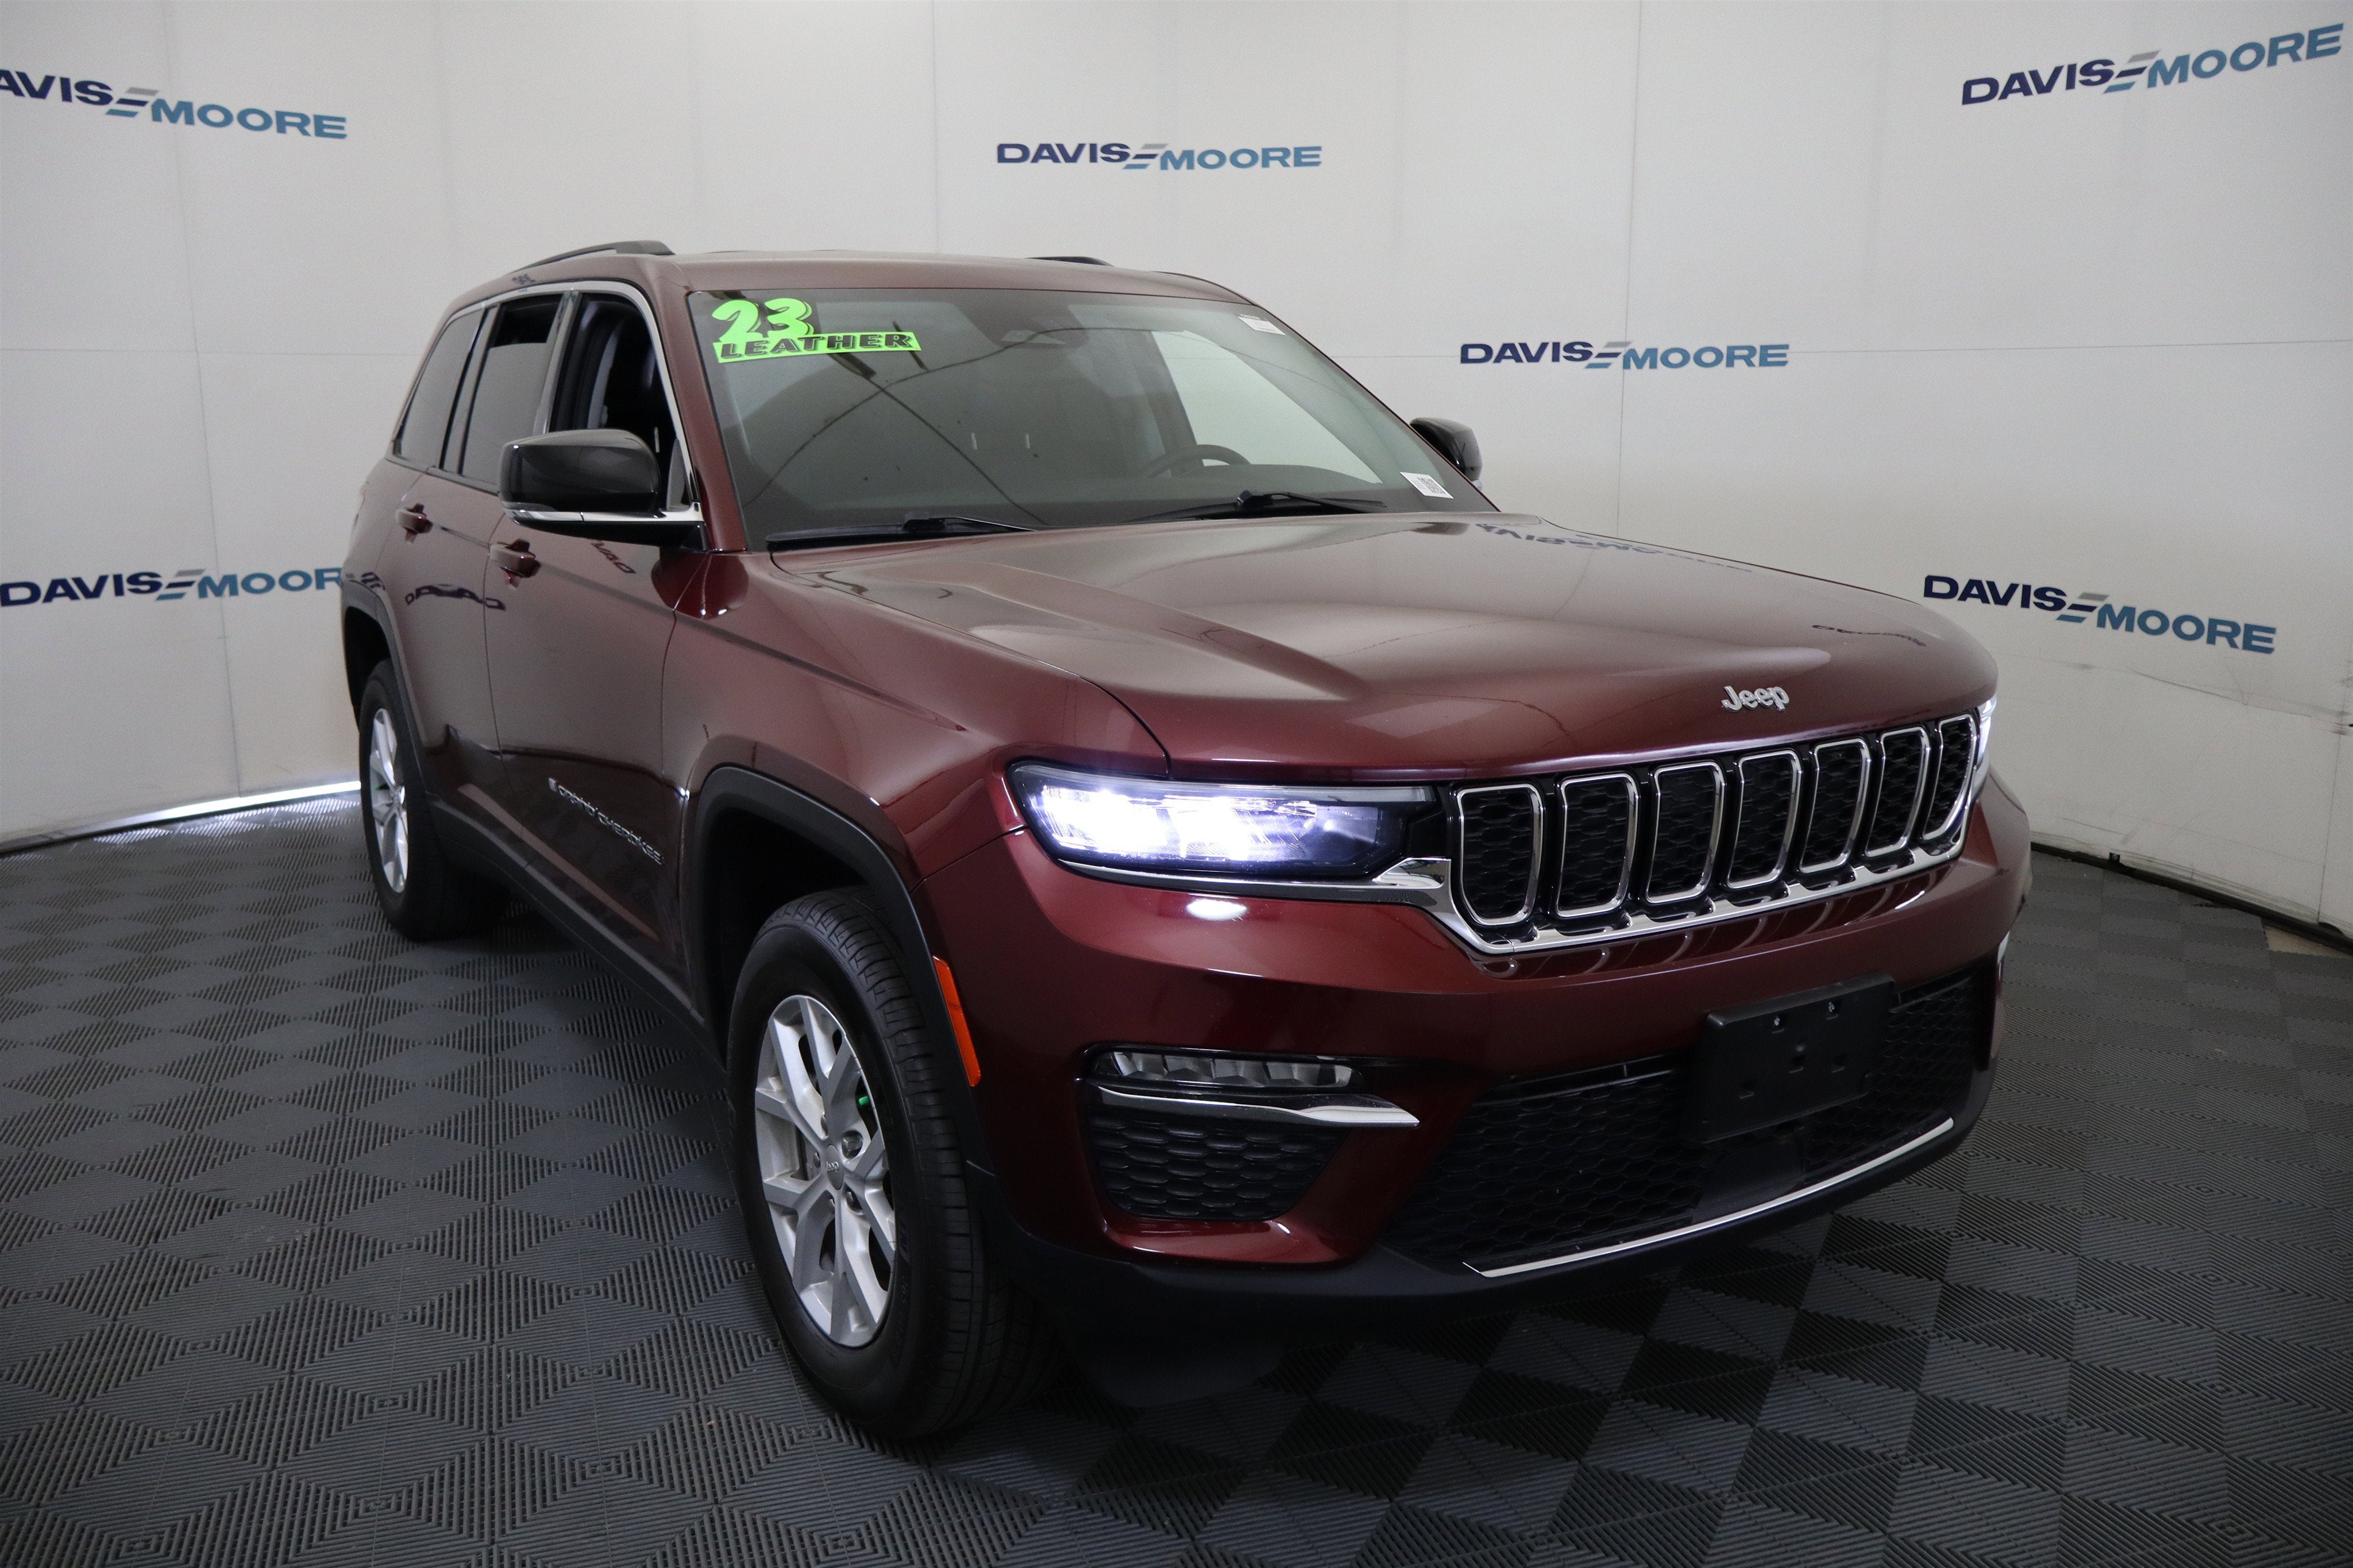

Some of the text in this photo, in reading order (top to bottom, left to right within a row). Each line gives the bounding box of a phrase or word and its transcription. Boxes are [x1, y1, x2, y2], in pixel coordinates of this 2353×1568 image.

[1962, 24, 2345, 105] DAVIS MOORE
[0, 69, 348, 140] AVIS MOORE
[997, 143, 1322, 171] DAVIS MOORE
[712, 298, 815, 341] 23
[720, 333, 913, 359] LEATHER
[1460, 341, 1790, 370] DAVIS MOORE
[0, 572, 163, 607] DAVIS
[198, 567, 343, 599] MOOR
[1924, 575, 2277, 654] DAVIS MOORE
[1721, 685, 1790, 712] Jeep
